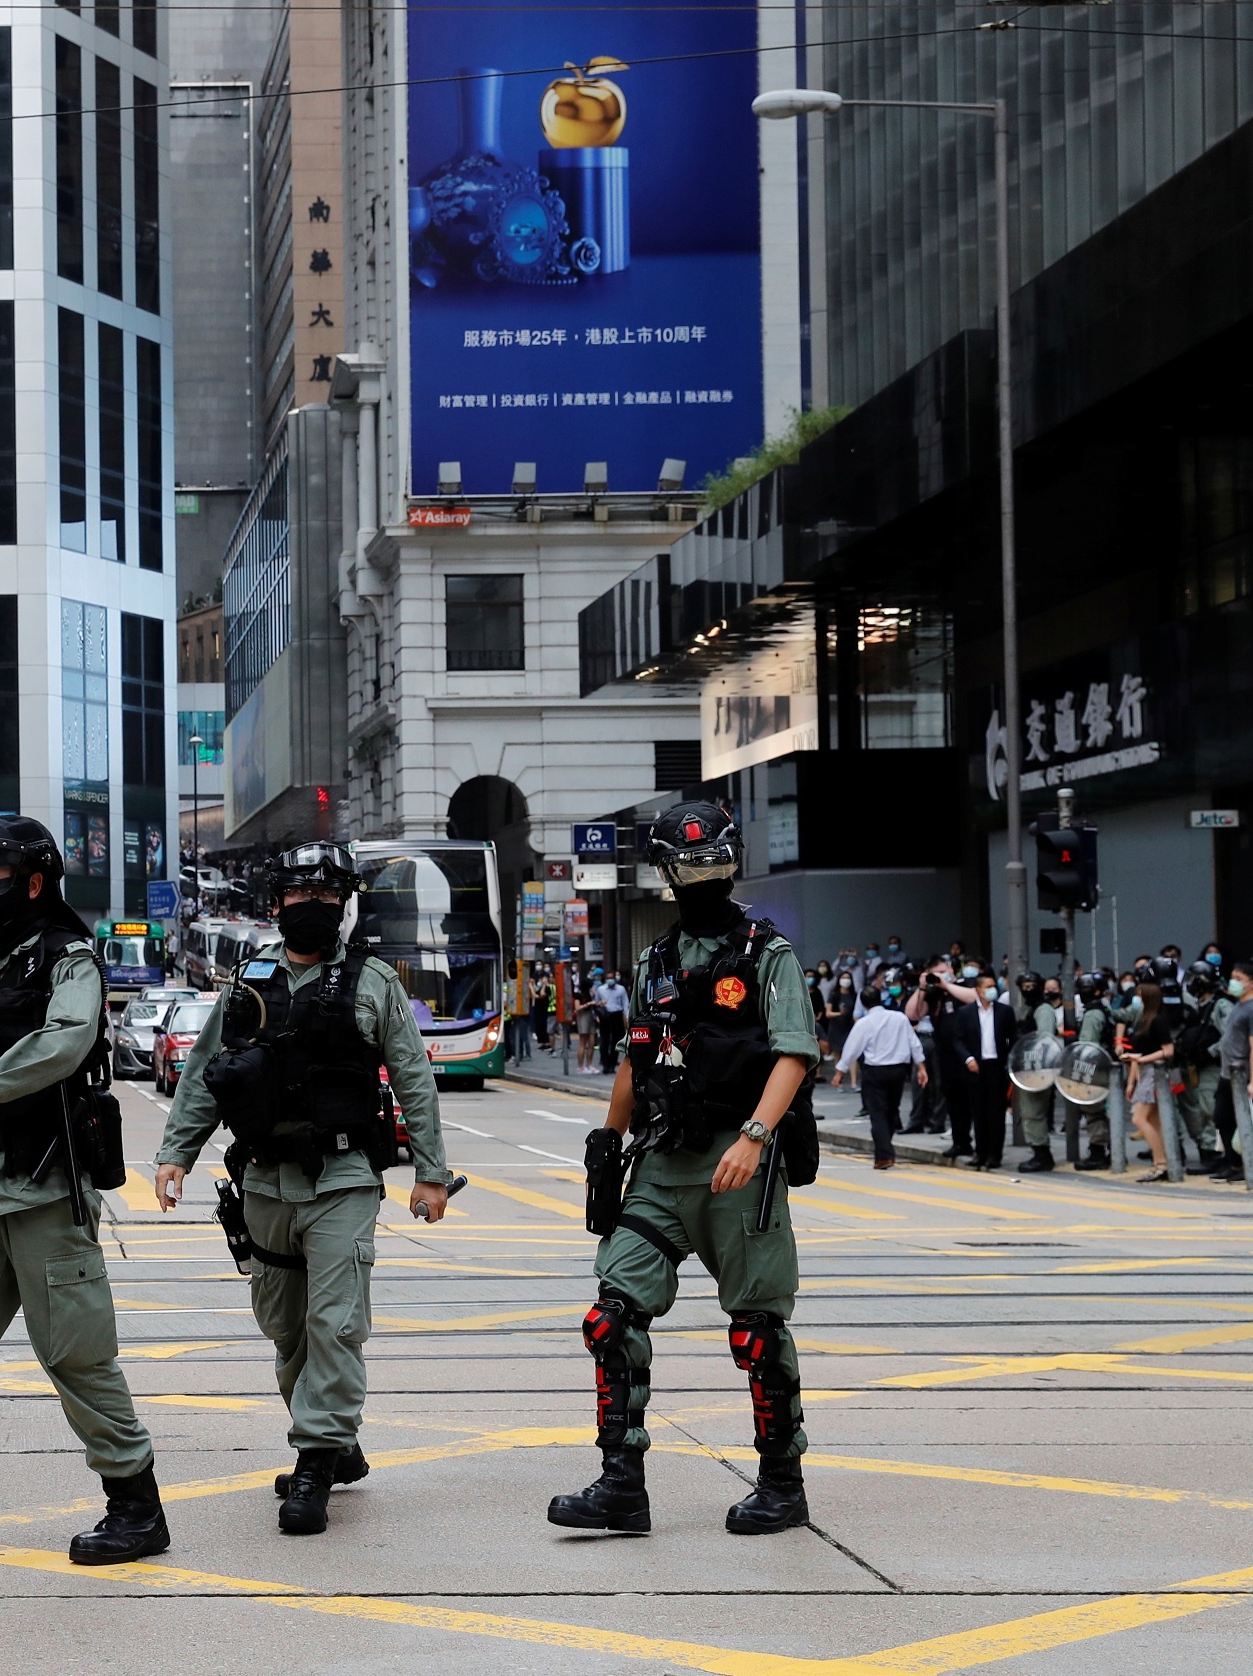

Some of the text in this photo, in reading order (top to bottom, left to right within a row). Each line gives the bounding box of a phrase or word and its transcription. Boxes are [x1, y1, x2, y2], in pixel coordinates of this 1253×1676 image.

[439, 394, 488, 408] 財富管理
[500, 393, 549, 407] 投資銀行
[561, 392, 610, 406] 資產管理
[425, 511, 471, 526] Asiaray
[1025, 673, 1147, 762] 交通銀行
